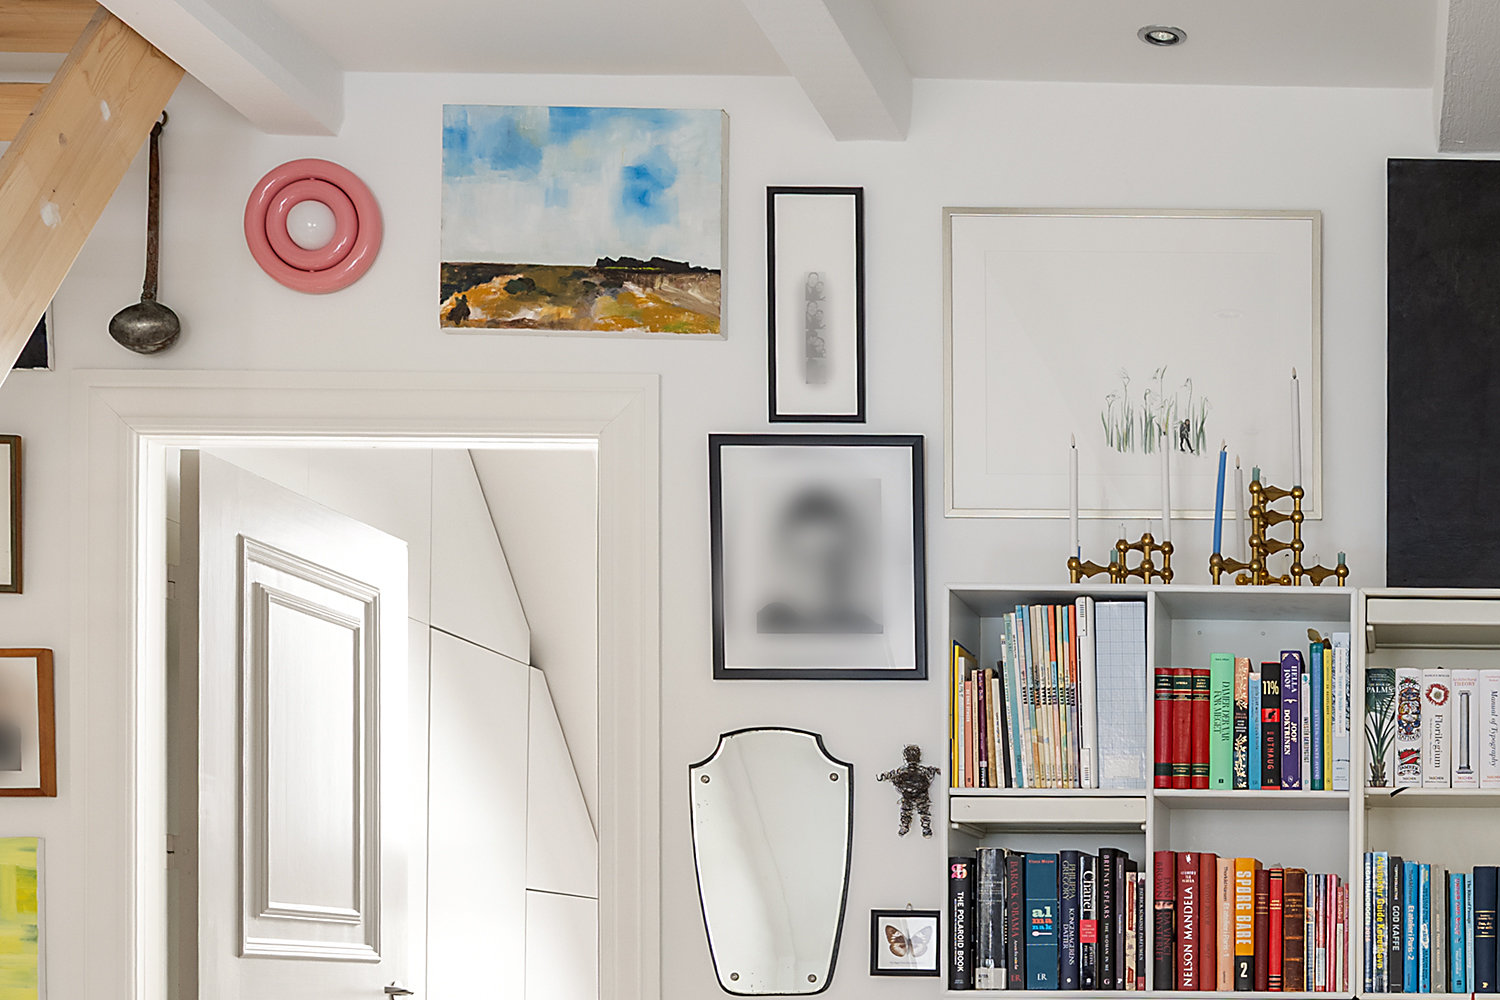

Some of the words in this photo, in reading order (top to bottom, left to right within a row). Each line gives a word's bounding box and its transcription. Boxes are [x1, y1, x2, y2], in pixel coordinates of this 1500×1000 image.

[1222, 681, 1230, 708] DAMER
[1262, 680, 1279, 695] 11%
[1222, 709, 1230, 724] DER
[1490, 690, 1498, 717] Manual
[1222, 724, 1230, 742] VAR
[1433, 714, 1444, 768] Florilegium
[1488, 727, 1498, 768] Typography
[1010, 860, 1018, 899] BARACK
[1083, 870, 1095, 912] Chanel
[1376, 856, 1384, 896] Arkitektur
[1011, 902, 1020, 938] OBAMA
[1032, 906, 1052, 918] al
[1164, 911, 1172, 926] DA
[1183, 886, 1193, 940] MANDELA
[1376, 898, 1384, 922] Guide
[1236, 914, 1252, 945] BARE
[1376, 924, 1384, 968] København
[1183, 944, 1193, 987] NELSON
[1240, 962, 1248, 978] 2
